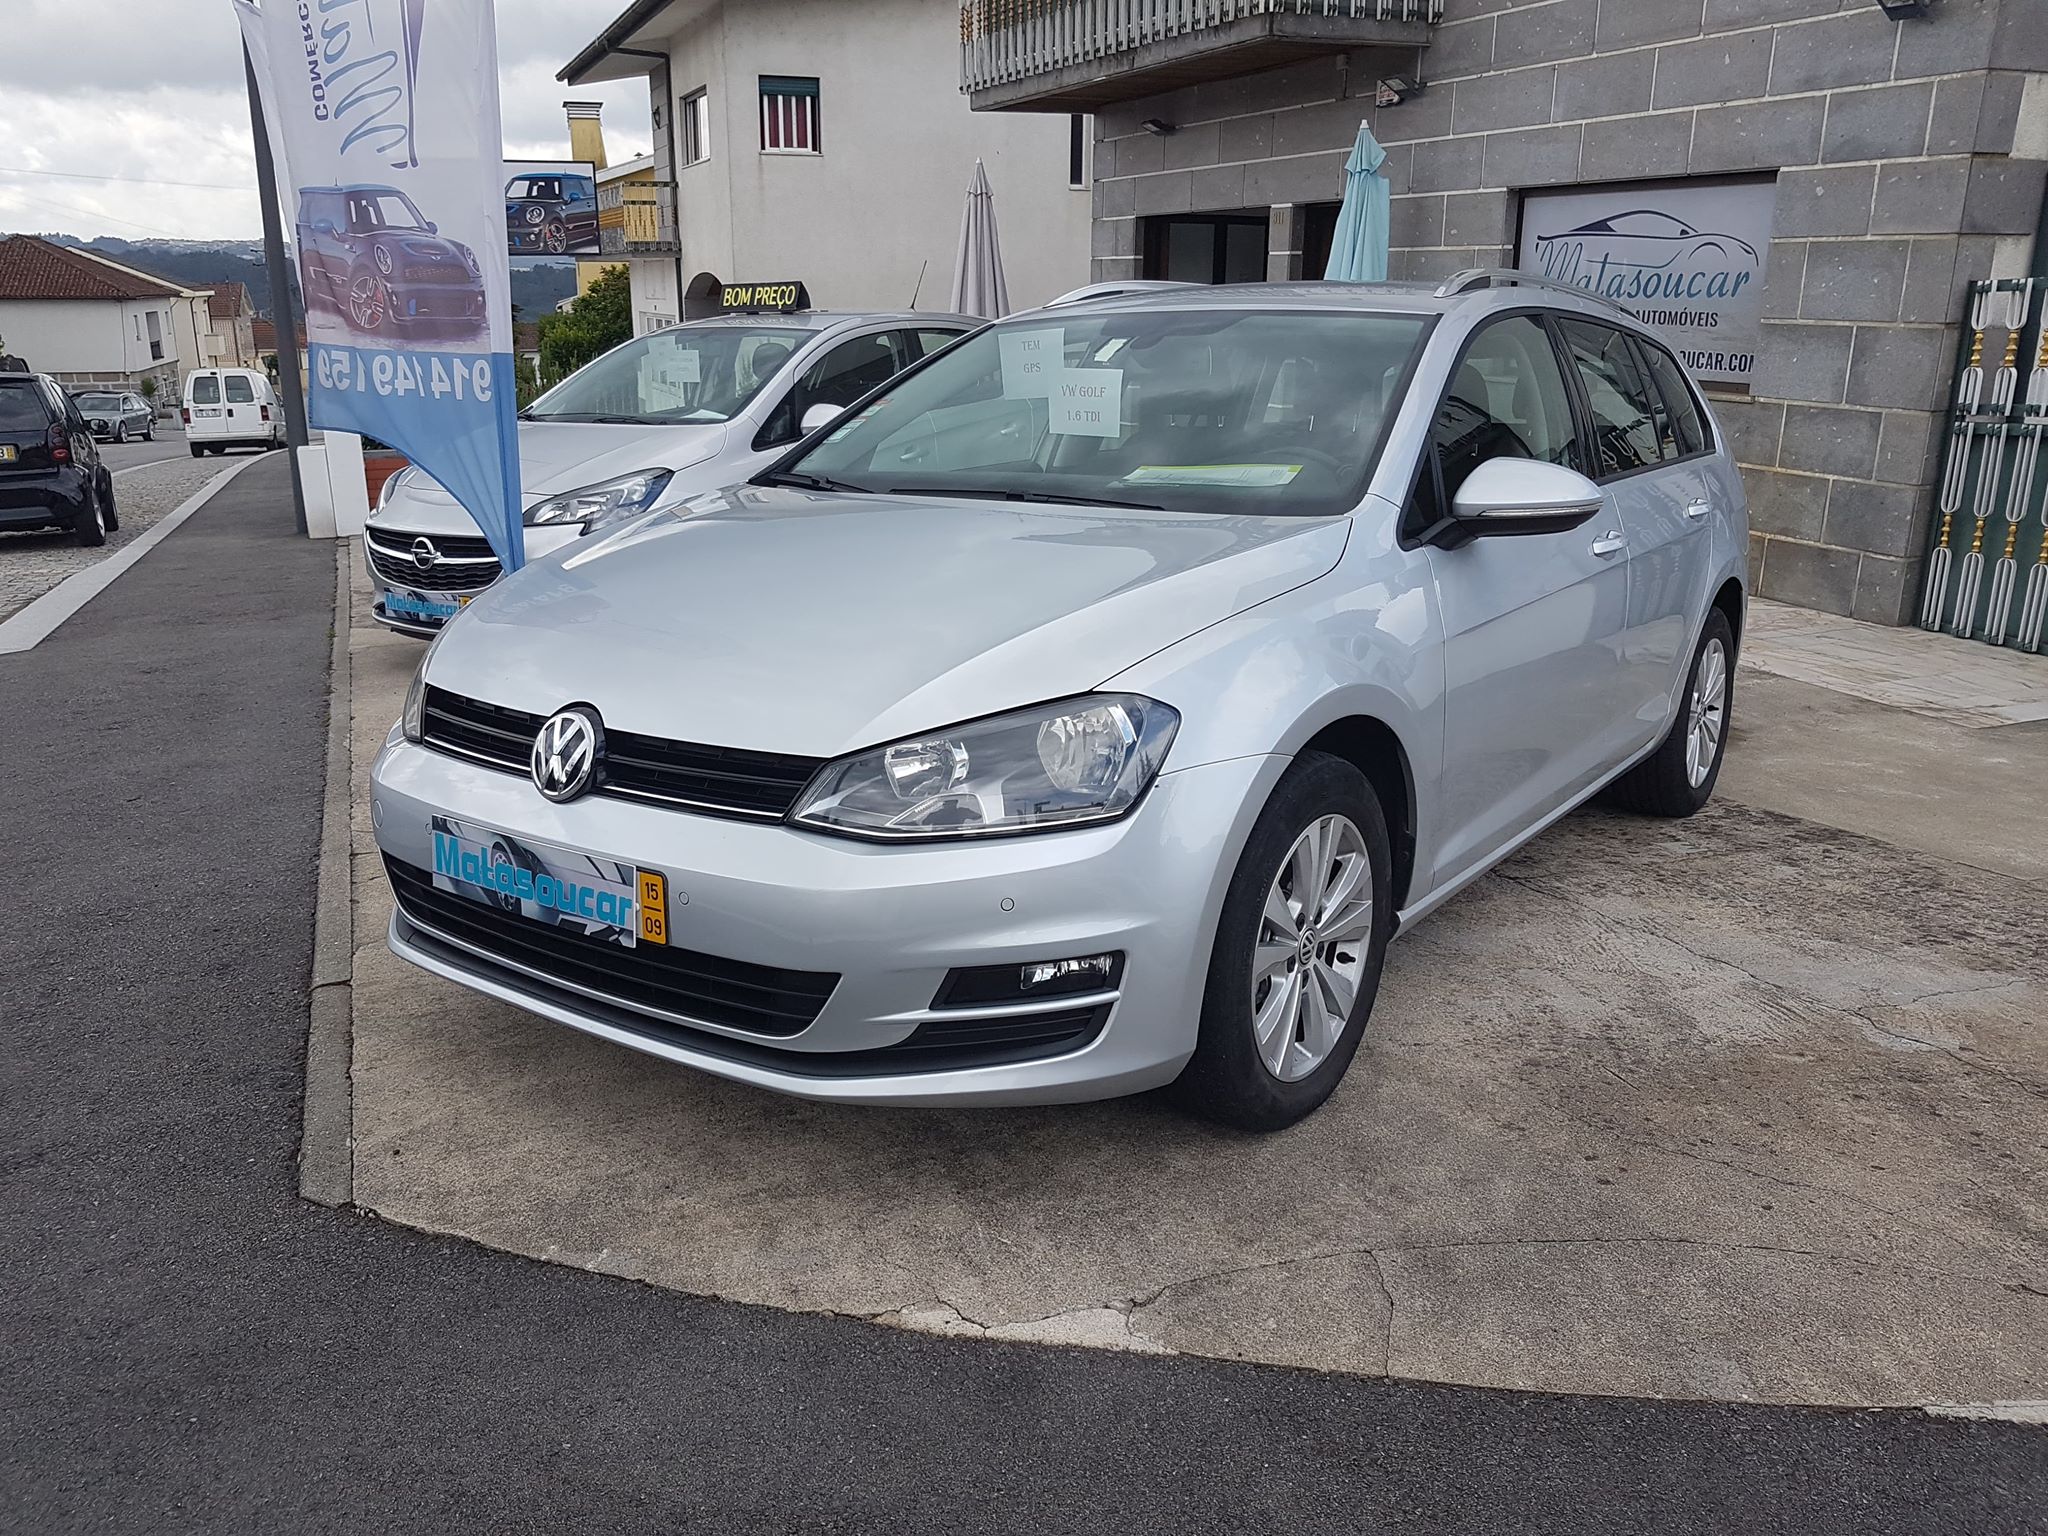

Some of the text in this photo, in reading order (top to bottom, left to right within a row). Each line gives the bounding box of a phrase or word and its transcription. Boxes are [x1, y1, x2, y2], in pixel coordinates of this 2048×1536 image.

[723, 285, 796, 309] BOM PREÇO
[1022, 341, 1040, 351] TEM
[1023, 363, 1041, 374] GPS
[1061, 384, 1107, 398] VW GOLF
[1067, 410, 1101, 422] 1.6 TDI
[435, 833, 633, 926] Matasoucar
[645, 882, 659, 901] 15
[645, 916, 662, 936] 09
